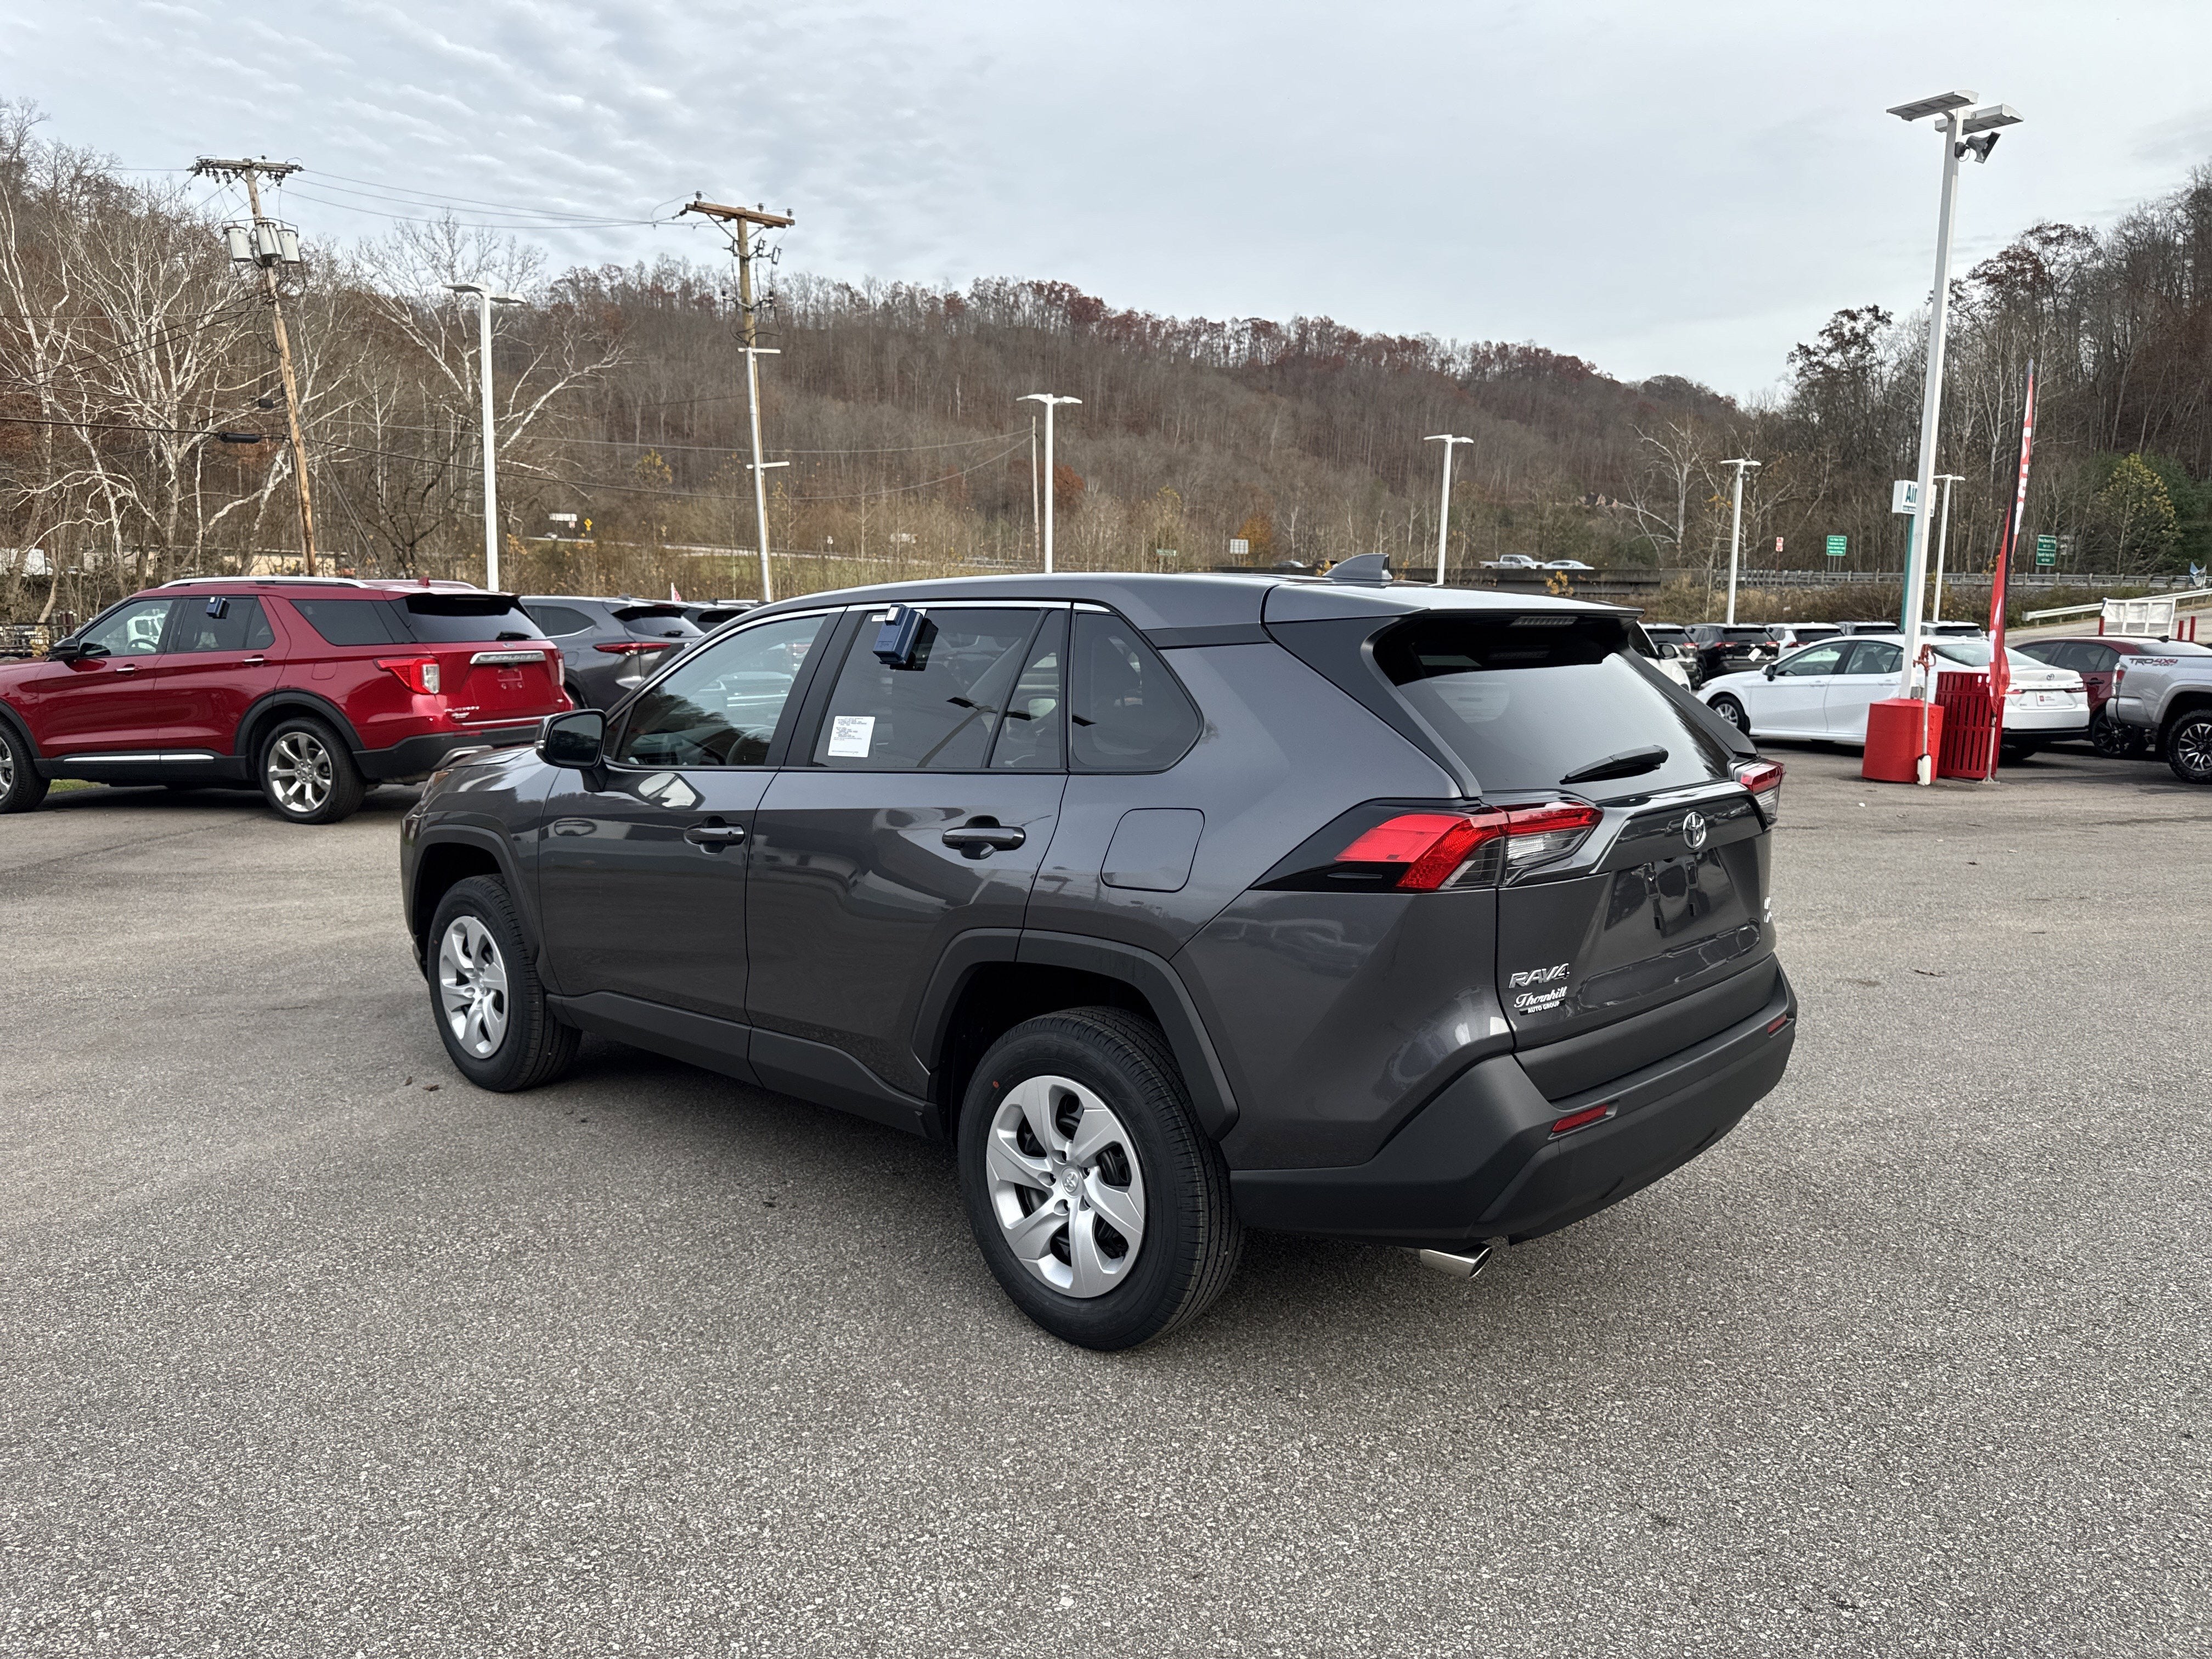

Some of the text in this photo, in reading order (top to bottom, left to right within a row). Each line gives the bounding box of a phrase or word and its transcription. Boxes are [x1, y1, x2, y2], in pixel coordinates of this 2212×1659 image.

[1509, 963, 1570, 989] RAV4
[1514, 986, 1567, 1008] Thornhill
[1527, 1001, 1560, 1014] AUTO GROUP
